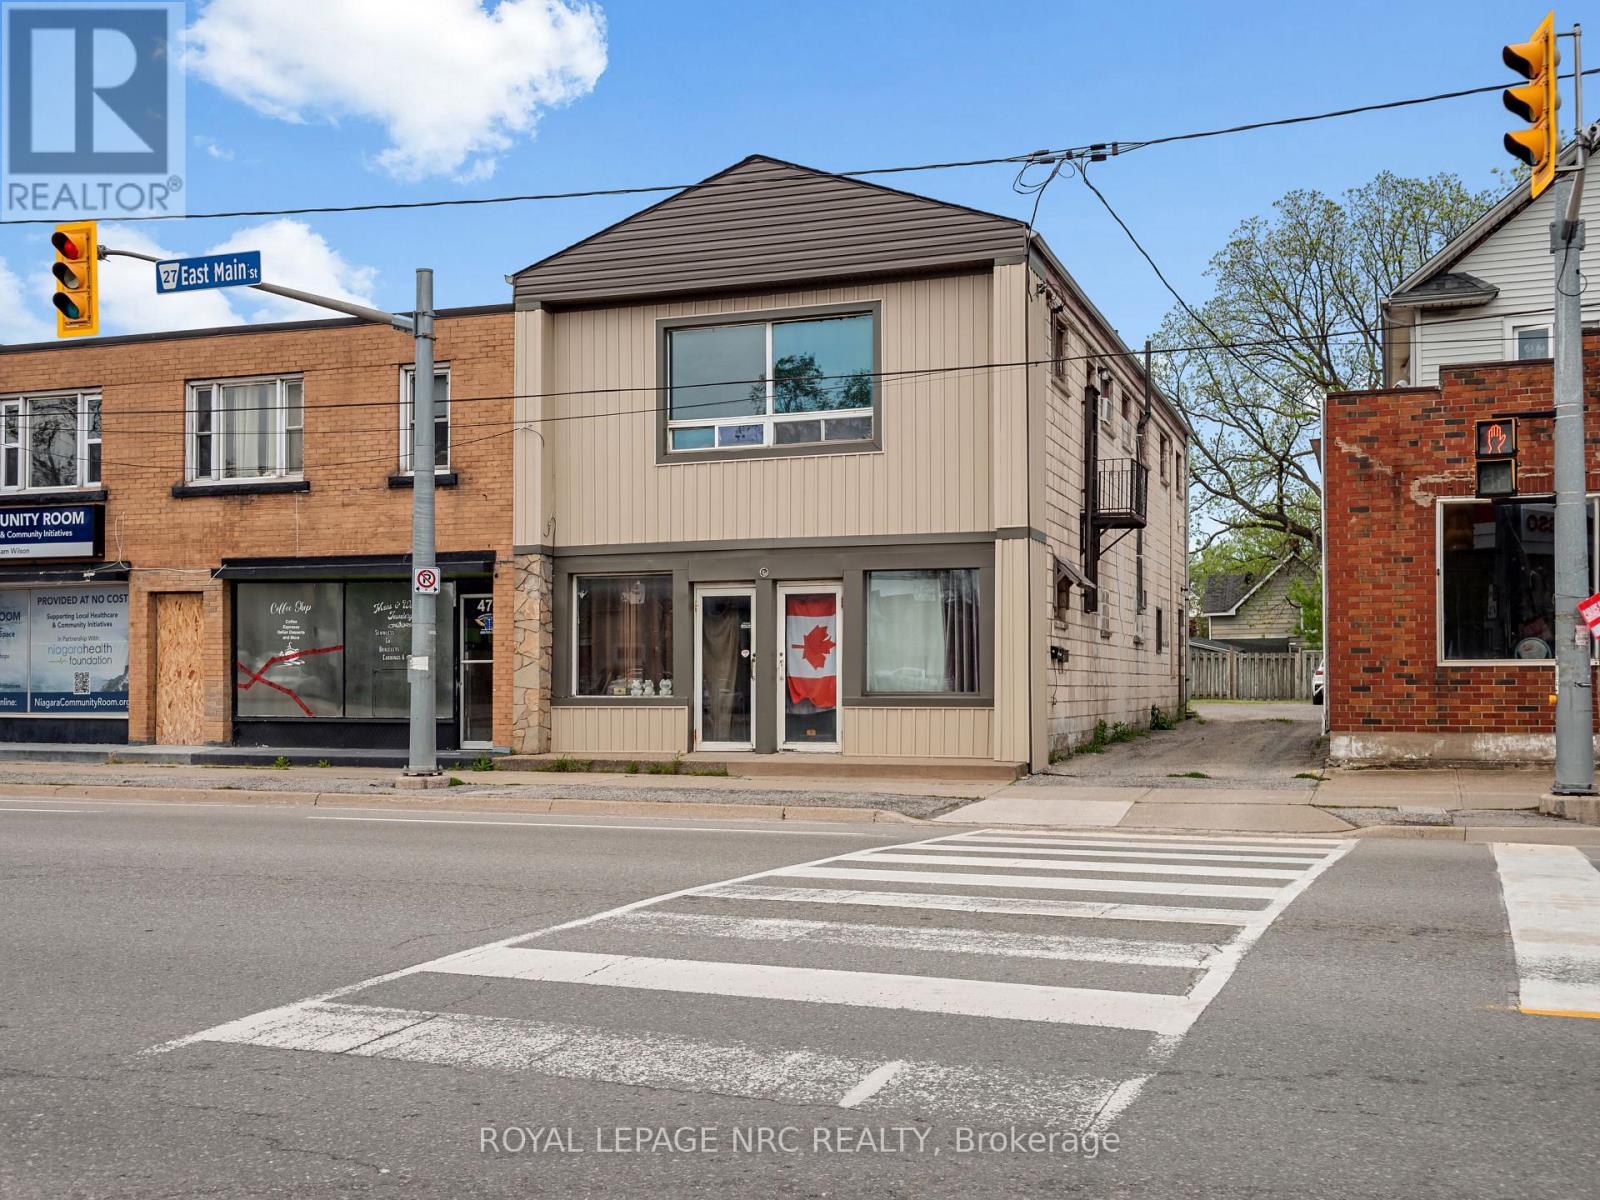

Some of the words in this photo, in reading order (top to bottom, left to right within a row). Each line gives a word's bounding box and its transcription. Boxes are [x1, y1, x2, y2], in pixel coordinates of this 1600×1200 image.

[163, 270, 177, 283] 27
[181, 264, 209, 285] East
[214, 259, 246, 282] Main
[43, 511, 84, 525] ROOM
[7, 530, 42, 539] Community
[43, 529, 73, 537] Initiatives
[37, 596, 77, 605] PROVIDED
[80, 595, 89, 604] AT
[92, 594, 105, 604] NO
[107, 593, 128, 603] COST
[270, 602, 291, 614] Coffee
[47, 642, 112, 656] niagarahealth
[69, 656, 112, 665] foundation
